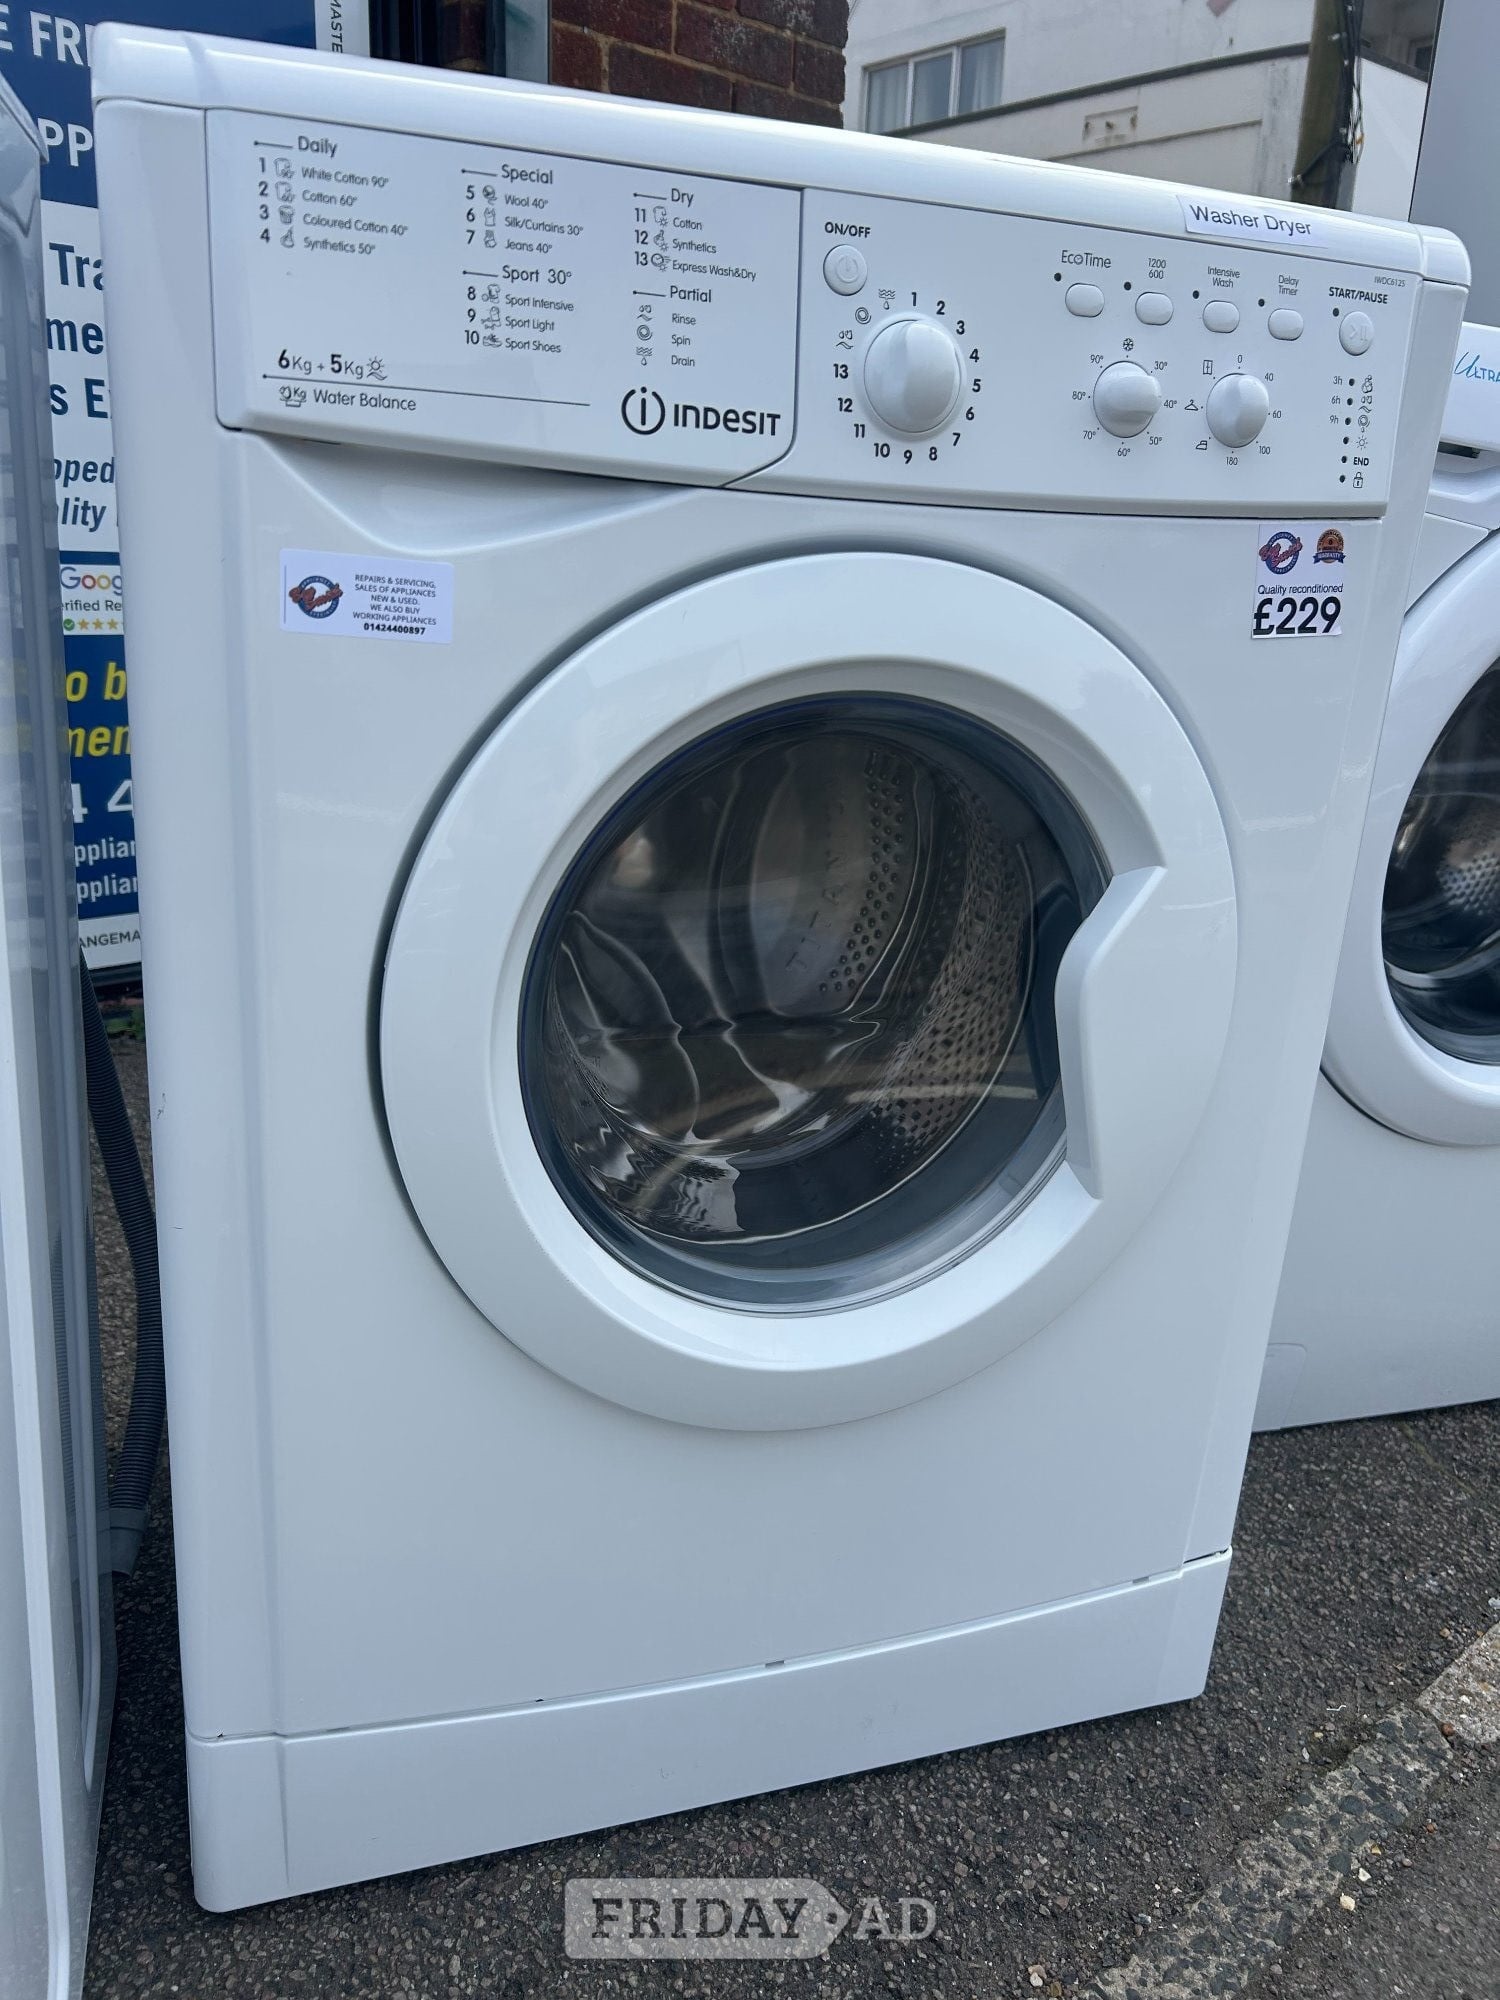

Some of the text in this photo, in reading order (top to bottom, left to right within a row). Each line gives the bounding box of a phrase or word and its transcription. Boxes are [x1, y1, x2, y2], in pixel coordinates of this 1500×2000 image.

[298, 135, 338, 158] Daily
[259, 157, 266, 173] 1
[301, 166, 332, 181] White
[334, 171, 369, 187] Cotton
[501, 164, 553, 184] Special
[258, 181, 268, 197] 2
[466, 185, 475, 200] 5
[302, 190, 337, 205] Cotton
[505, 194, 530, 208] Wool
[671, 188, 694, 207] Dry
[259, 204, 269, 220] 3
[466, 208, 476, 222] 6
[634, 208, 646, 223] 11
[303, 213, 352, 230] Coloured
[354, 219, 388, 234] Cotton
[505, 216, 565, 234] Silk/Curtains
[673, 217, 703, 231] Cotton
[1189, 204, 1311, 236] Washer Dryer
[260, 228, 270, 243] 4
[466, 230, 475, 244] 7
[634, 229, 649, 245] 12
[824, 221, 871, 239] ON/OFF
[303, 236, 356, 253] Synthetics
[505, 239, 534, 252] Jeans
[672, 239, 717, 254] Synthetics
[634, 251, 649, 267] 13
[1061, 250, 1112, 269] EcoTime
[1148, 257, 1167, 269] 1200
[502, 265, 572, 284] Sport 30°
[672, 260, 757, 282] Express Wash&Dry
[1149, 269, 1164, 280] 600
[1207, 266, 1240, 278] Intensive
[1212, 277, 1234, 288] Wash
[1278, 274, 1299, 288] Delay
[467, 286, 476, 301] 8
[670, 285, 712, 303] Partial
[1278, 285, 1298, 296] Timer
[1328, 286, 1388, 304] START/PAUSE
[505, 294, 574, 312] Sport Intensive
[911, 292, 918, 307] 1
[936, 300, 945, 315] 2
[467, 308, 476, 323] 9
[672, 313, 696, 326] Rinse
[505, 316, 555, 332] Sport Light
[956, 320, 965, 335] 3
[464, 329, 479, 345] 10
[672, 335, 691, 347] Spin
[505, 338, 561, 353] Sport Shoes
[671, 355, 695, 367] Drain
[969, 348, 979, 363] 4
[1237, 355, 1243, 364] 0
[833, 363, 848, 379] 13
[1264, 373, 1274, 382] 40
[972, 379, 981, 393] 5
[1333, 376, 1343, 385] 3h
[313, 389, 417, 412] Water Balance
[838, 397, 853, 413] 12
[1331, 395, 1341, 405] 6h
[965, 406, 975, 421] 6
[1272, 410, 1282, 419] 60
[1329, 415, 1339, 424] 9h
[854, 424, 865, 438] 11
[952, 433, 961, 447] 7
[874, 443, 890, 458] 10
[903, 450, 913, 464] 9
[928, 446, 938, 461] 8
[1258, 446, 1271, 455] 100
[1226, 457, 1238, 466] 180
[1353, 457, 1369, 466] END
[355, 574, 386, 584] REPAIRS
[354, 583, 377, 592] SALES
[391, 587, 436, 598] APPLIANCES
[1258, 582, 1344, 596] Quality reconditioned
[62, 600, 100, 611] rified
[371, 594, 389, 602] NEW
[384, 605, 403, 613] ALSO
[1253, 596, 1341, 635] £229
[353, 611, 437, 626] WORKING APPLIANCES
[363, 622, 426, 635] 01424400897
